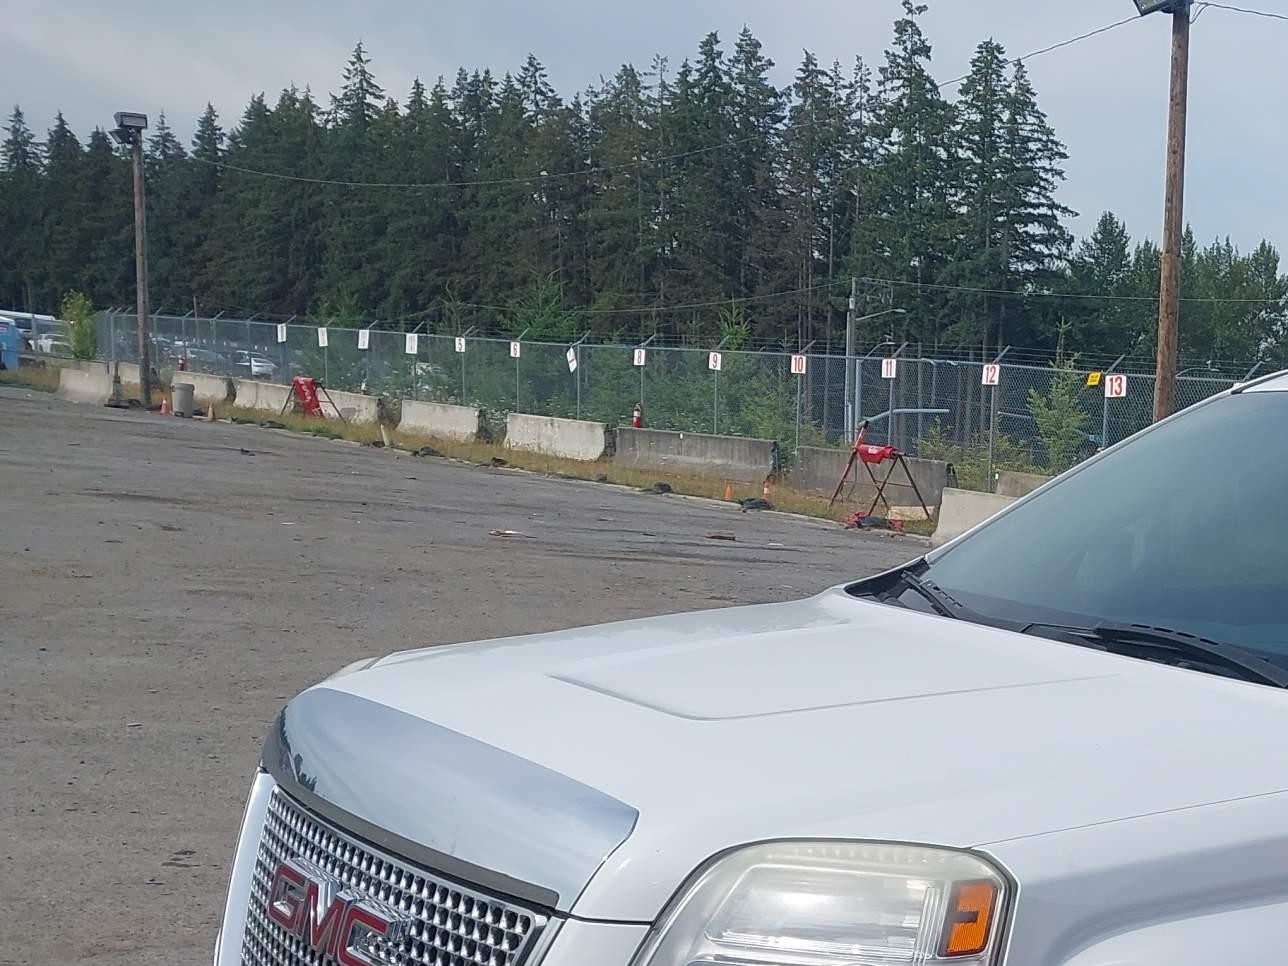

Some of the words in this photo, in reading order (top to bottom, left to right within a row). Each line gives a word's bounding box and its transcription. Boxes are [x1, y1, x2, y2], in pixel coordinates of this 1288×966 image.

[712, 353, 718, 368] 9
[794, 357, 804, 373] 10
[885, 360, 893, 376] 11
[985, 366, 996, 384] 12
[1109, 376, 1123, 396] 13
